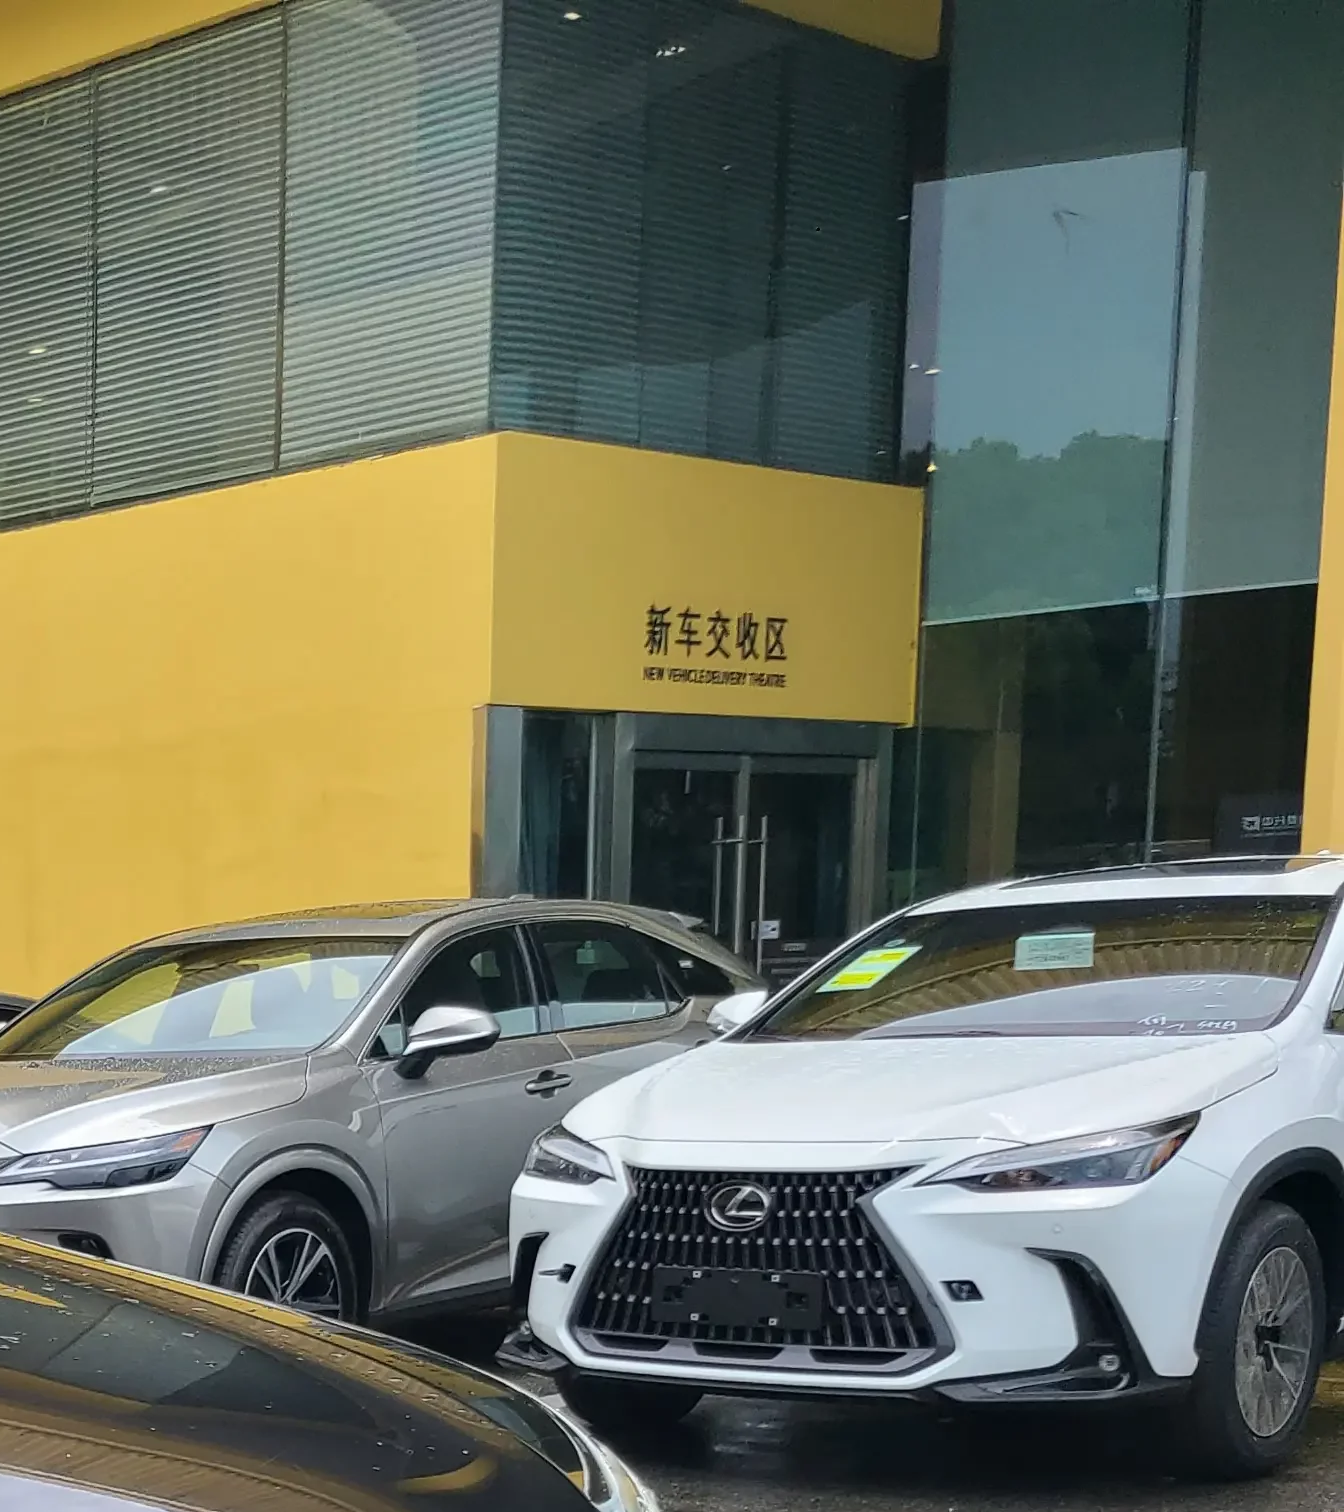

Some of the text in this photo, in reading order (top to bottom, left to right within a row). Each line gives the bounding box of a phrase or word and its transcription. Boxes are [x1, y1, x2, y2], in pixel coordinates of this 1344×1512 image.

[644, 604, 788, 662] 新车交收区
[643, 667, 664, 681] NEW
[668, 668, 705, 683] VEHICLE
[706, 671, 746, 686] DELIVERY
